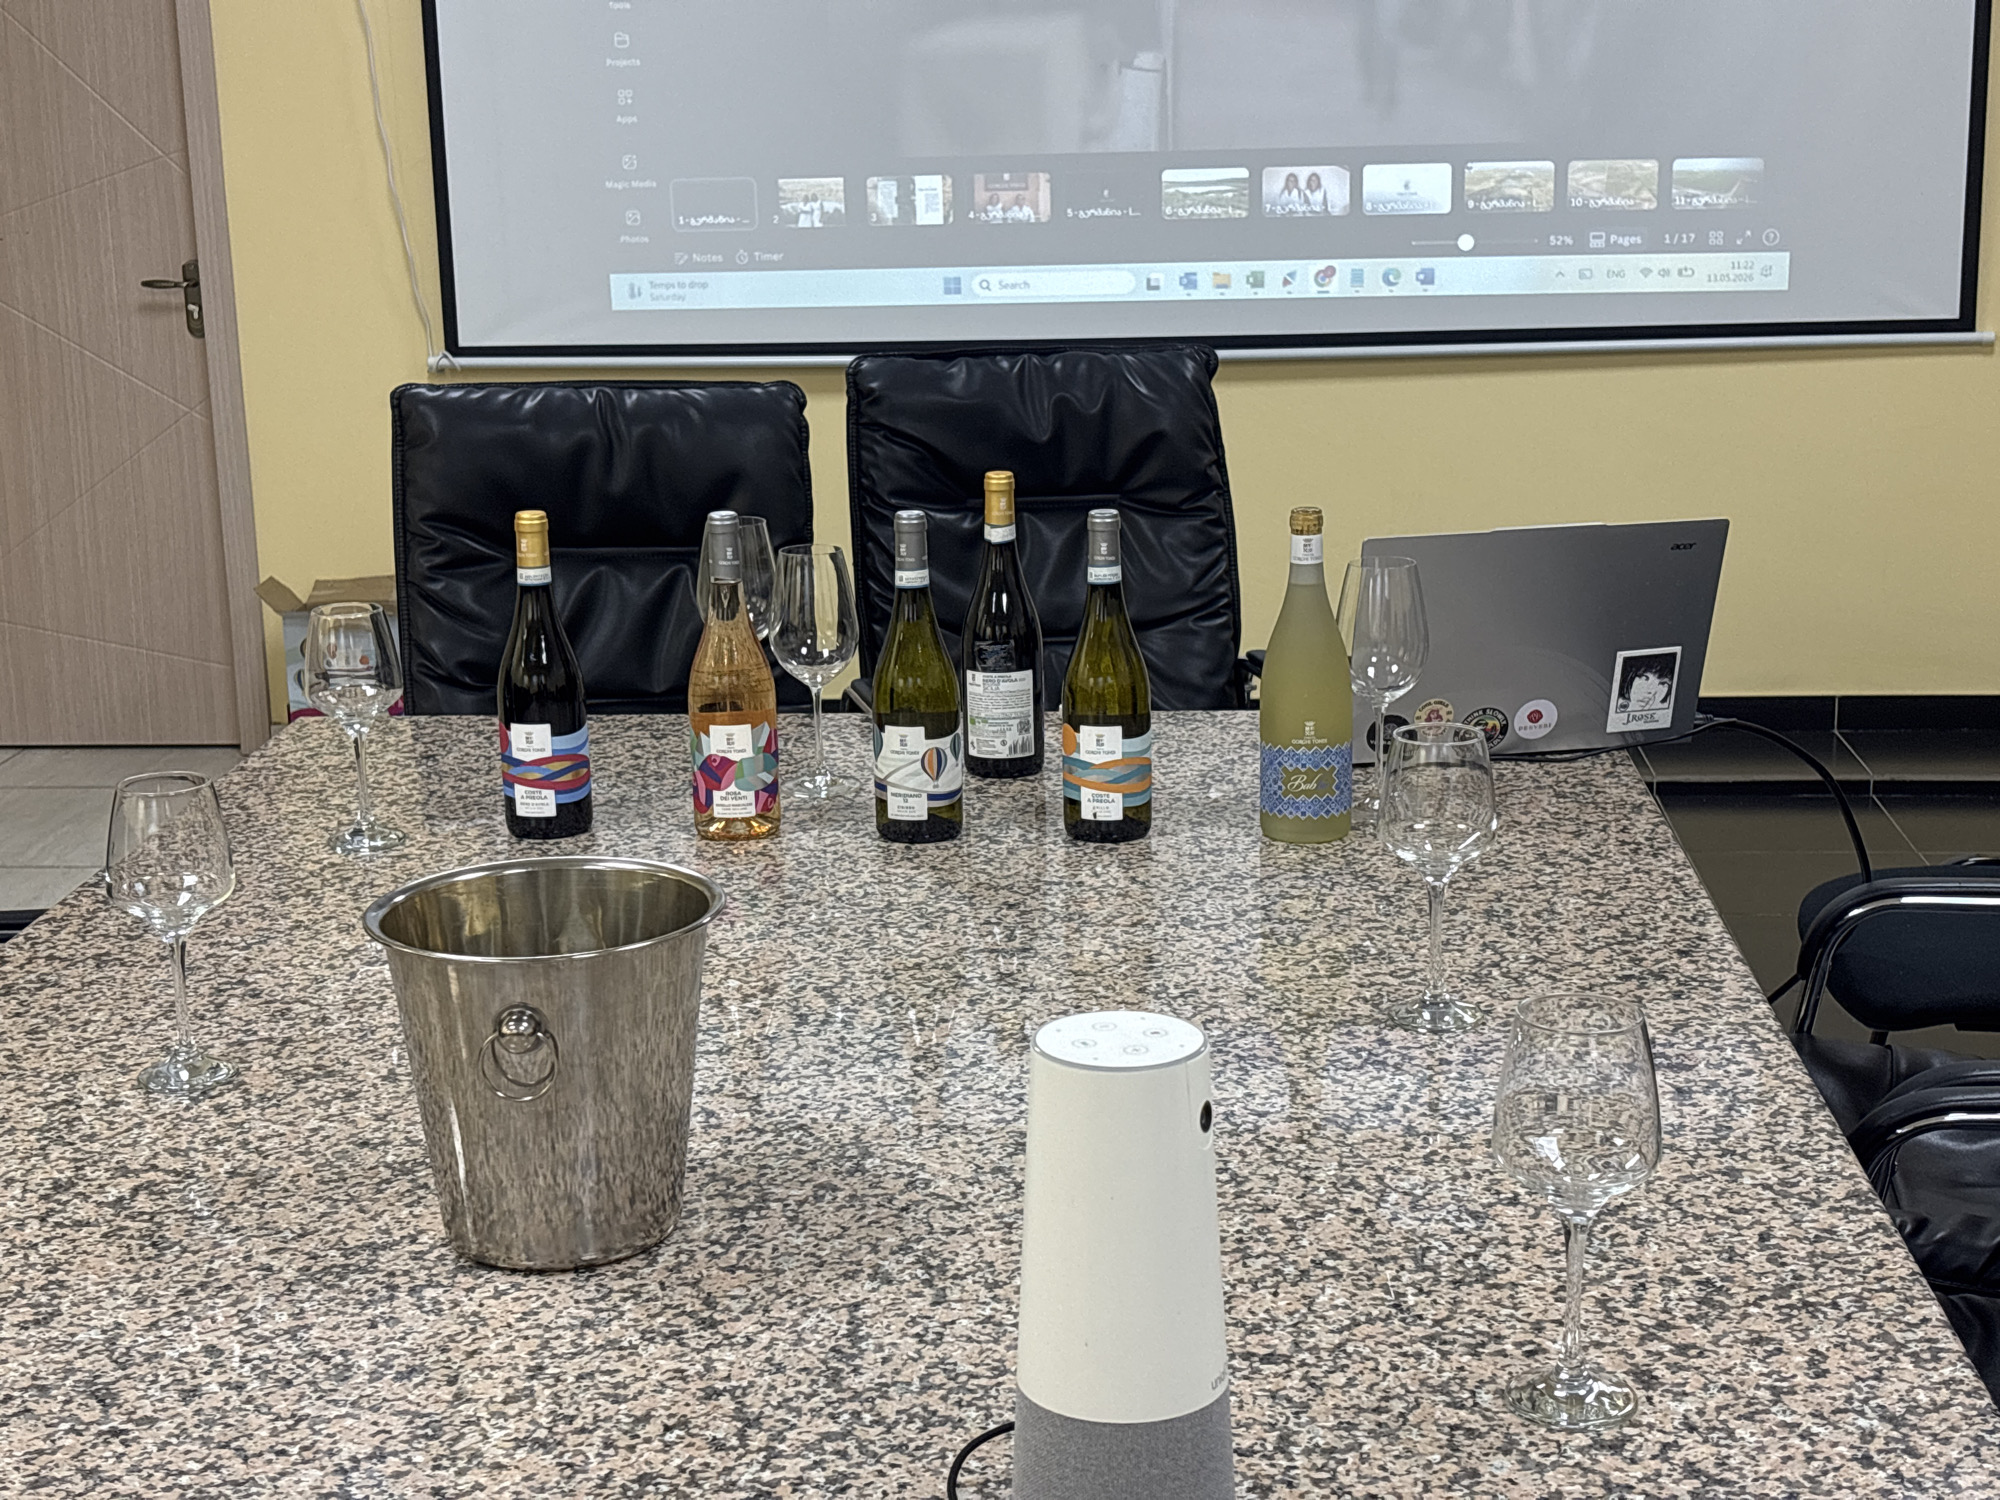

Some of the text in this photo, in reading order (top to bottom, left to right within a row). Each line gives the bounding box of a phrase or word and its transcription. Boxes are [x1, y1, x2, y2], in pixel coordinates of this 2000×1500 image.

[609, 1, 631, 10] Tools
[606, 58, 641, 68] Projects
[616, 115, 638, 125] Apps
[605, 179, 656, 190] Magic Media
[1467, 200, 1474, 209] 9
[1570, 198, 1583, 207] 10
[1674, 196, 1685, 205] 11
[1066, 208, 1073, 217] 5
[1165, 206, 1173, 215] 6
[1265, 204, 1271, 213] 7
[678, 216, 684, 225] 1
[772, 216, 779, 224] 2
[870, 213, 878, 222] 3
[620, 235, 650, 244] Photos
[1549, 236, 1574, 246] 52%
[1610, 234, 1642, 247] Pages
[692, 253, 723, 262] Notes
[754, 252, 784, 261] Timer
[1606, 269, 1626, 279] ENG
[649, 280, 709, 291] Temps to drop
[998, 281, 1030, 290] Search
[650, 293, 686, 302] Saturday
[1670, 542, 1697, 550] acer
[1463, 709, 1484, 725] THINK
